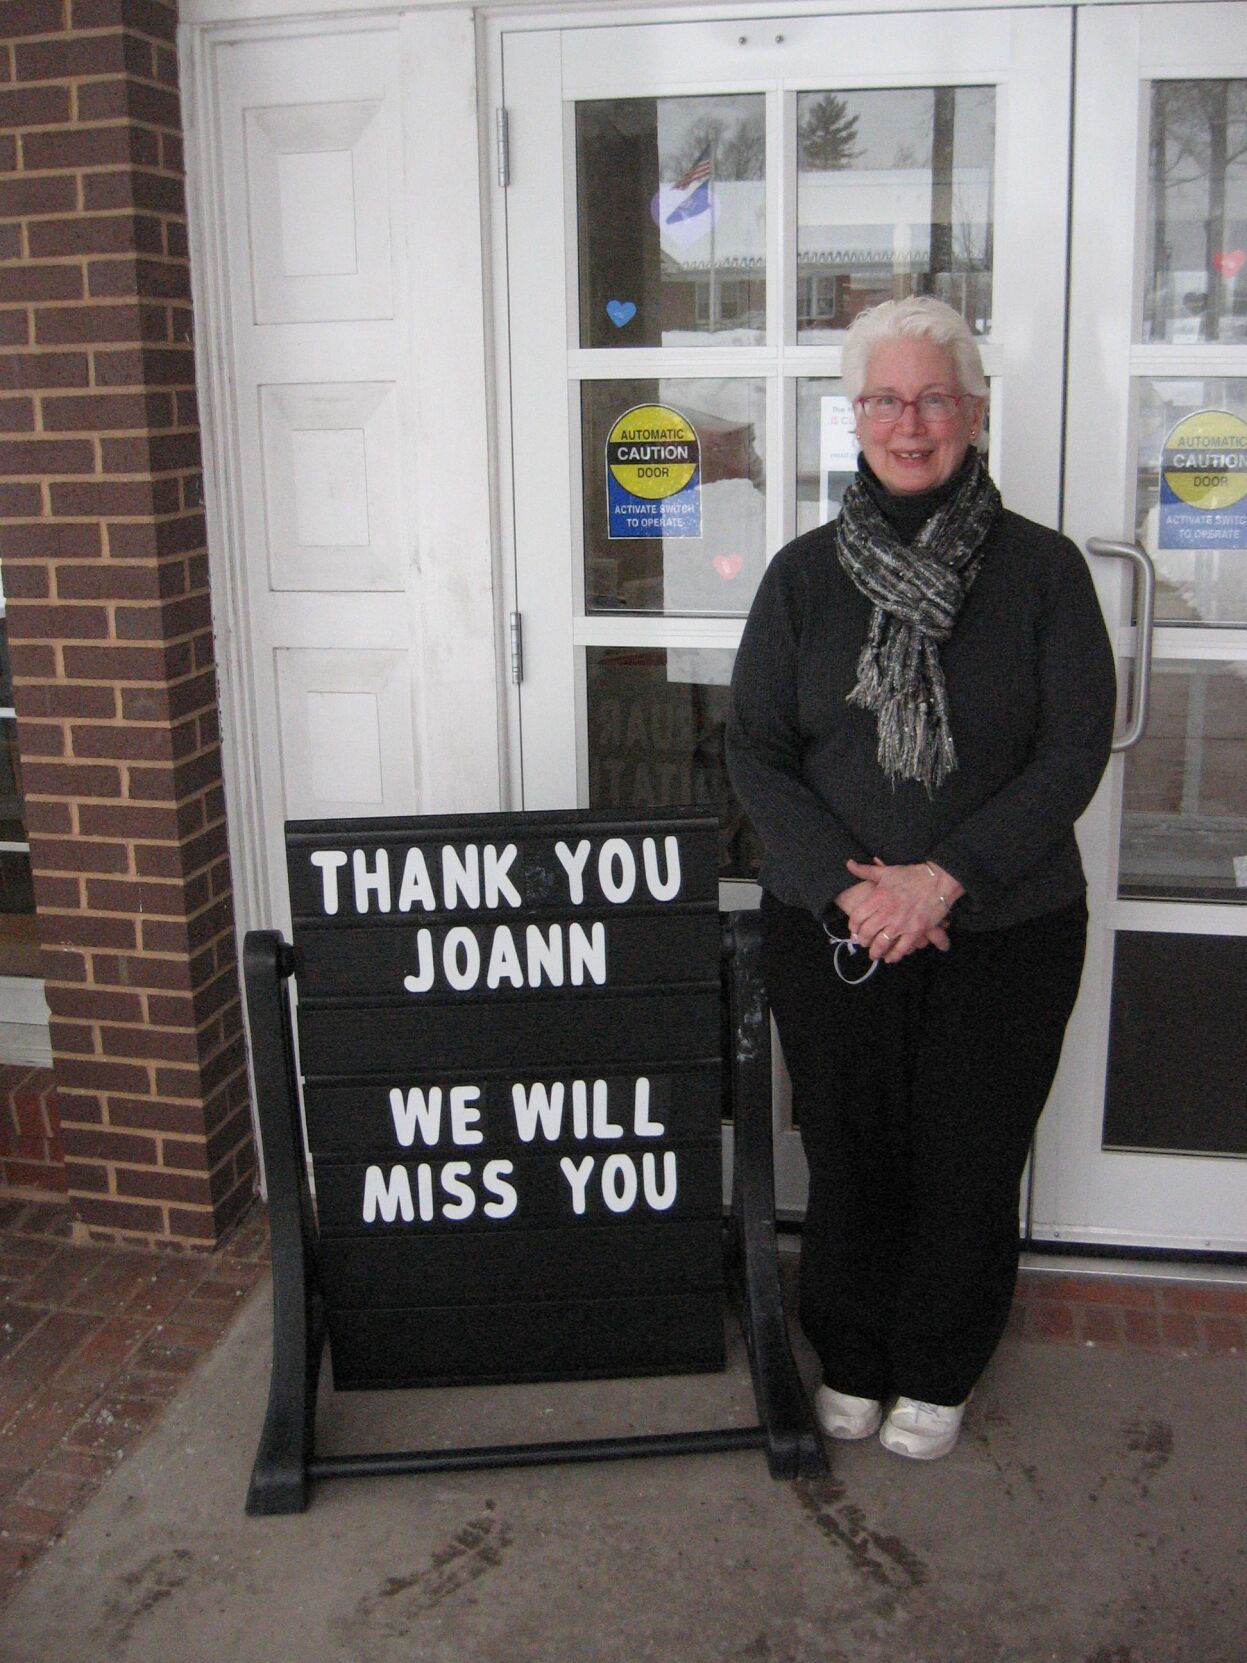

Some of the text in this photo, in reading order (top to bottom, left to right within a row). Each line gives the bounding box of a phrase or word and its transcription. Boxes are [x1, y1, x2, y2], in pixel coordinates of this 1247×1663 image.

[621, 429, 684, 440] AUTOMATIC
[1178, 436, 1247, 447] AUTOMATIC
[617, 446, 688, 460] CAUTION
[1173, 454, 1247, 468] CAUTION
[637, 467, 669, 478] DOOR
[1194, 476, 1228, 487] DOOR
[615, 504, 695, 514] ACTIVATE SWITCH
[626, 518, 682, 527] TO OPERATE
[1166, 515, 1247, 525] ACTIVATE SWITC
[1179, 529, 1240, 539] TO OPERATE
[311, 836, 681, 915] THANK YOU
[404, 922, 606, 992] JOANN
[390, 1077, 665, 1146] WE WILL
[363, 1151, 677, 1222] MISS YOU
